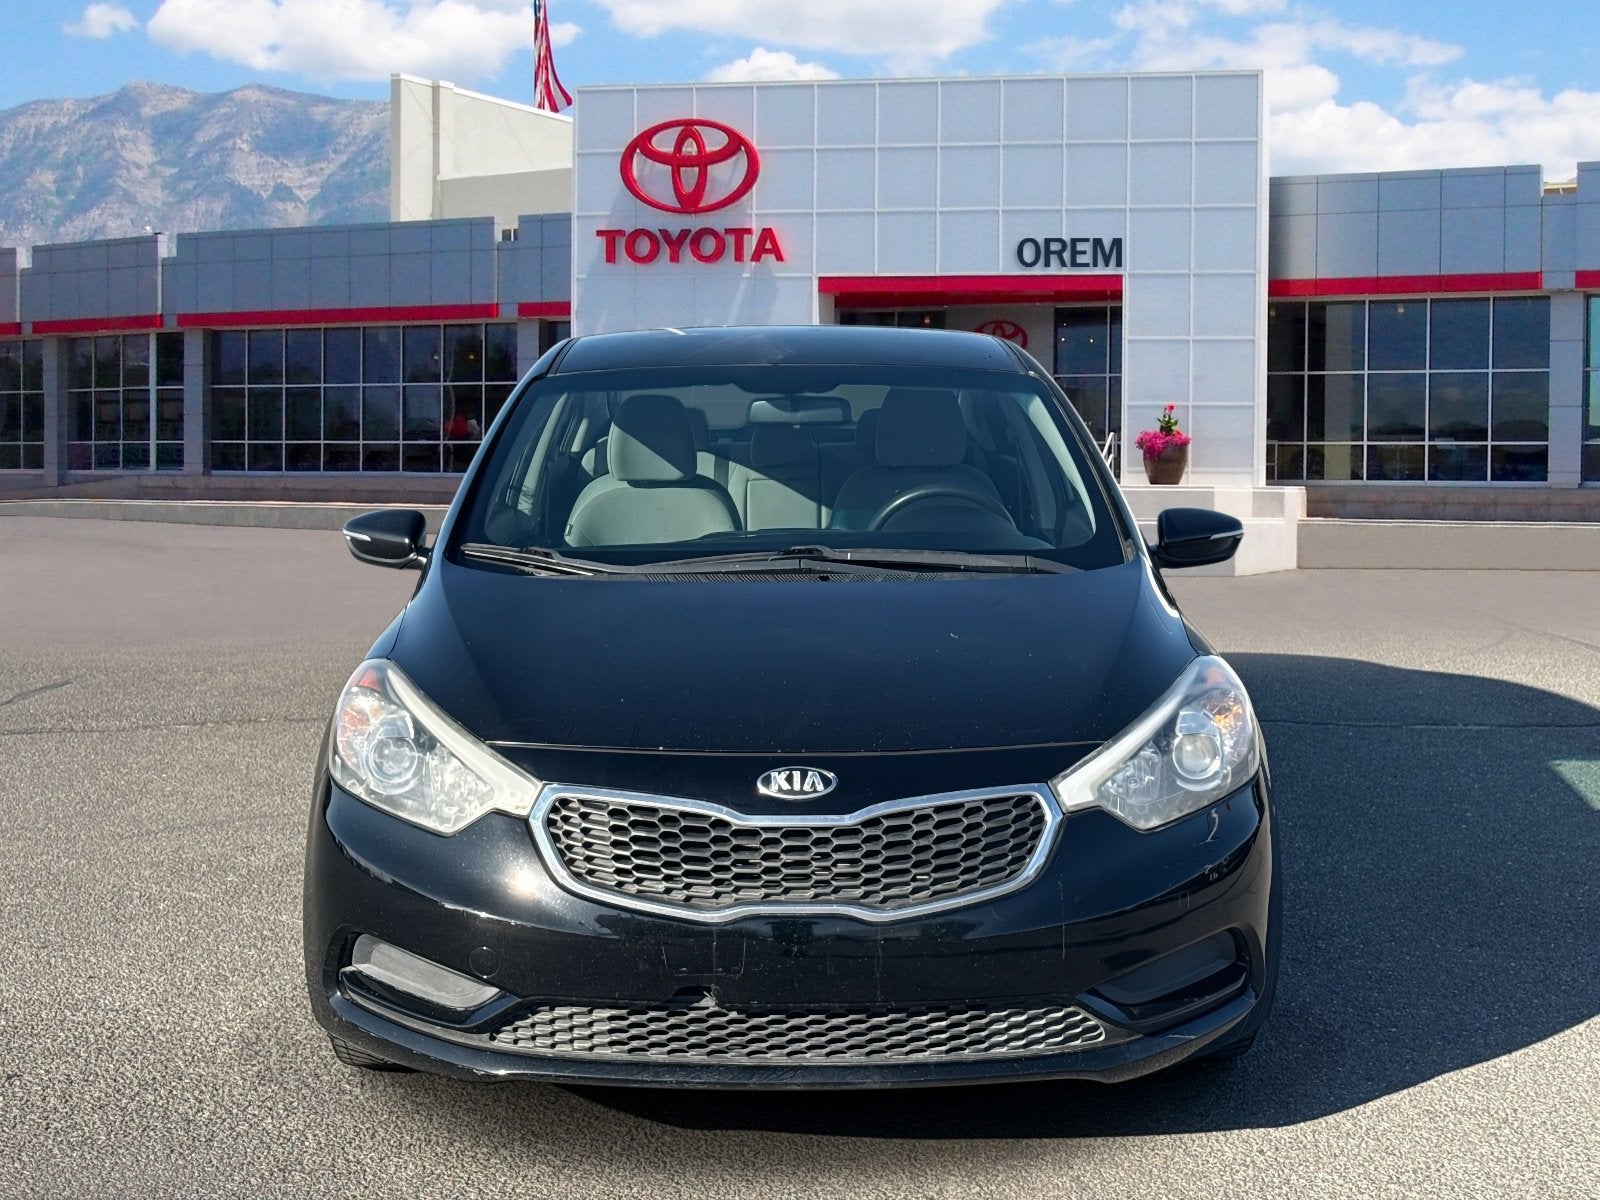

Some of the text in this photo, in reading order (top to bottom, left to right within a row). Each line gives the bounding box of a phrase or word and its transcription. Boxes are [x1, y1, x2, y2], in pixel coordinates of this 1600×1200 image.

[596, 227, 784, 264] TOYOTA
[1017, 237, 1123, 268] OREM
[769, 770, 825, 792] KIA
